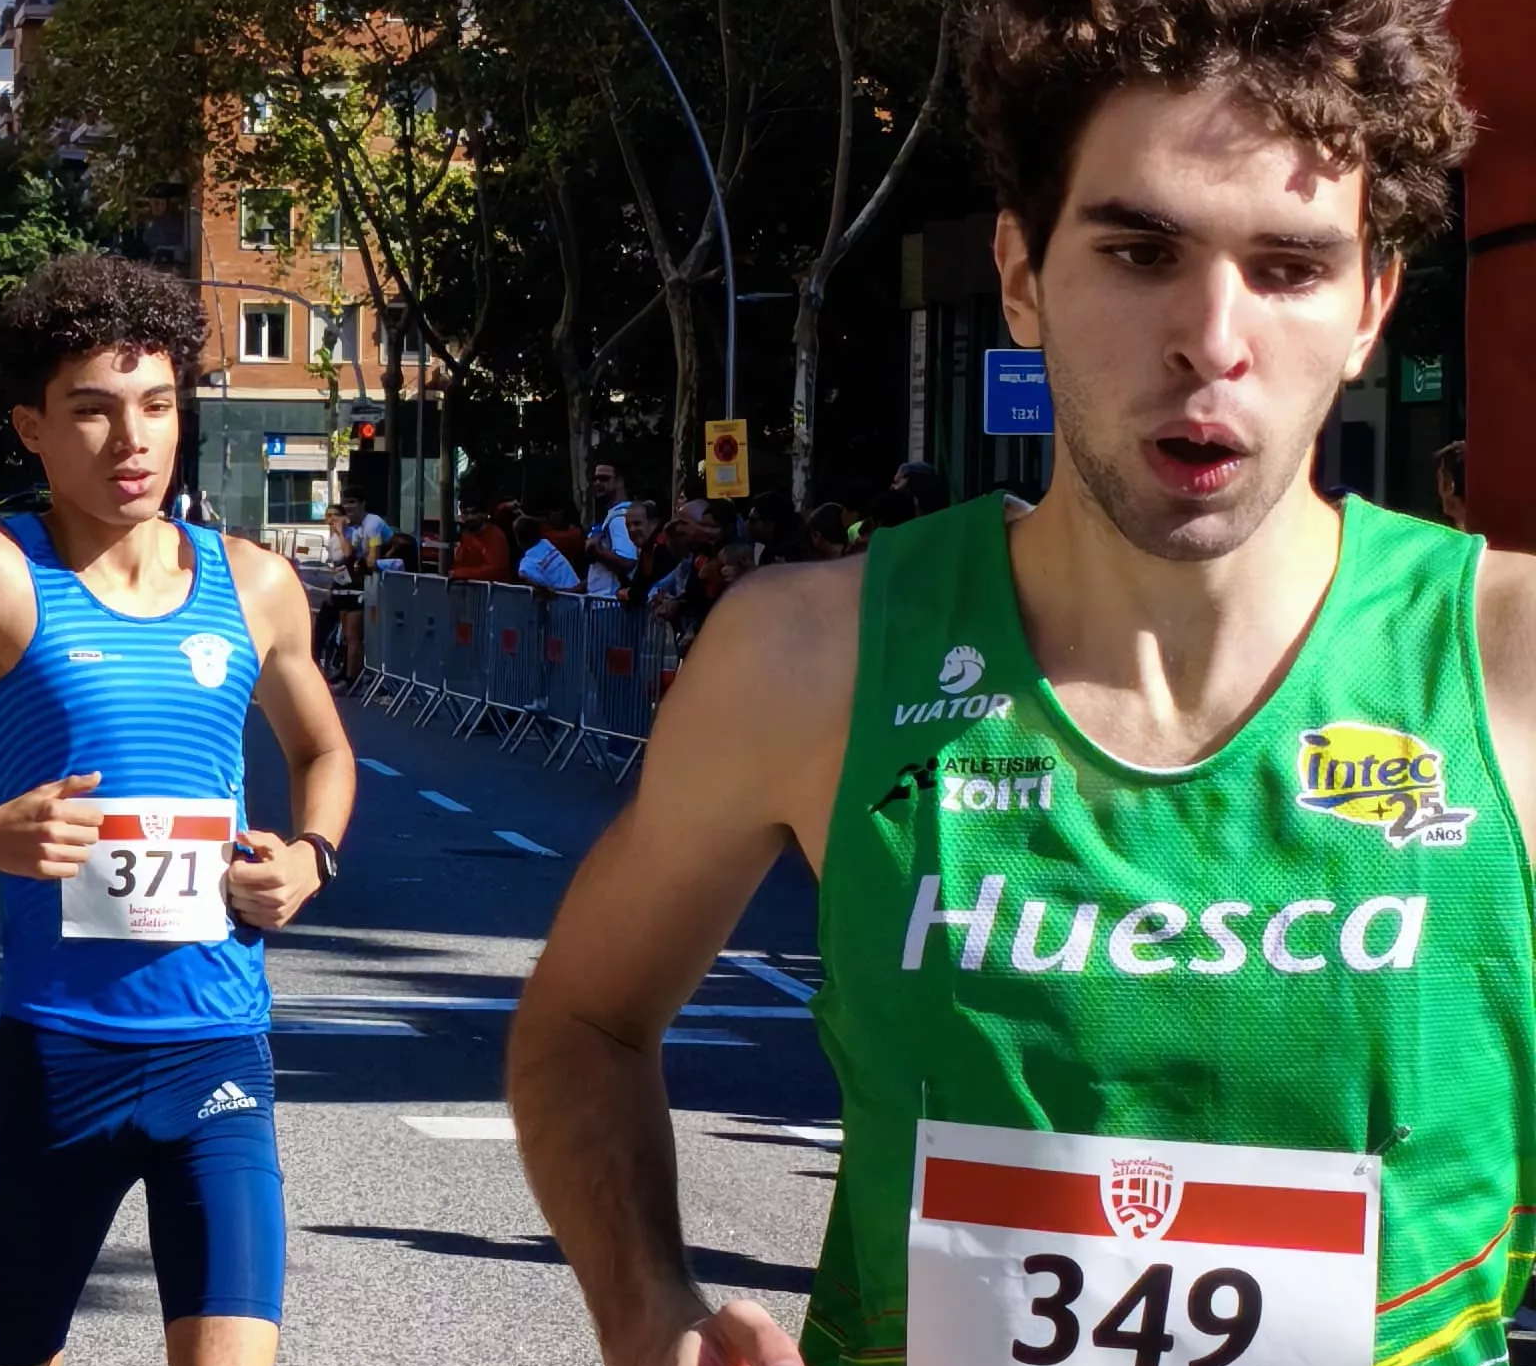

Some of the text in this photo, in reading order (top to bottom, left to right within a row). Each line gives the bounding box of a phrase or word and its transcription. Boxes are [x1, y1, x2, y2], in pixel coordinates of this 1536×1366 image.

[1011, 405, 1040, 420] taxi
[894, 694, 1013, 726] VIATOR
[944, 756, 1057, 774] ATLETISMO
[940, 774, 1053, 811] ZOITI
[1425, 828, 1463, 842] AÑOS
[107, 849, 198, 898] 371
[901, 874, 1429, 974] Huesca
[197, 1096, 258, 1120] adidas
